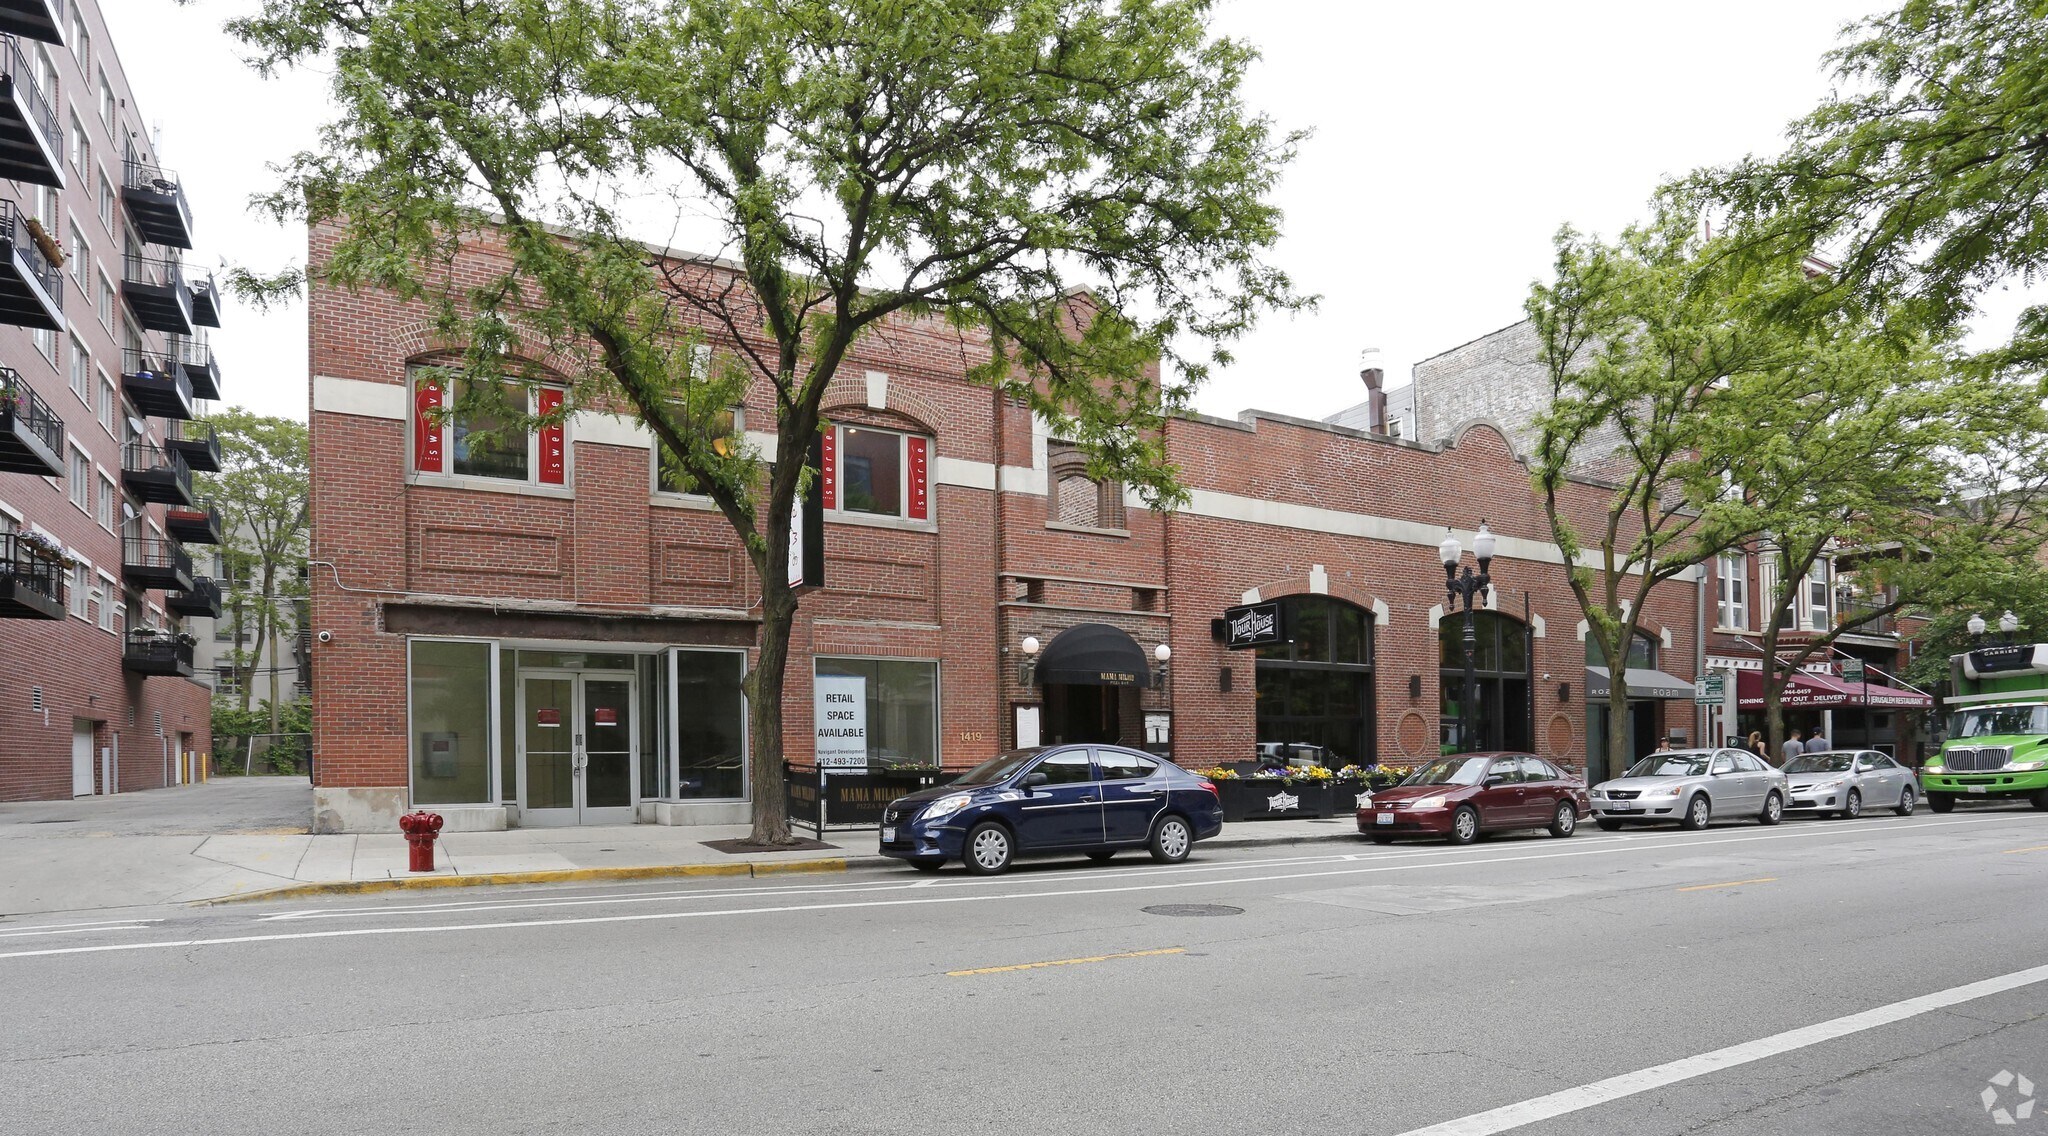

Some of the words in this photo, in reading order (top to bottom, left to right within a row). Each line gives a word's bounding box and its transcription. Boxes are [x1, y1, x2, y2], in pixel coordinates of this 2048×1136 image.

[429, 385, 438, 455] swve
[551, 401, 560, 468] swere
[826, 693, 855, 703] RETAIL
[1870, 696, 1895, 704] JERUSALEM
[827, 711, 854, 720] SPACE
[817, 728, 864, 737] AVAILABLE
[960, 731, 982, 741] 1419
[840, 788, 869, 801] MAMA
